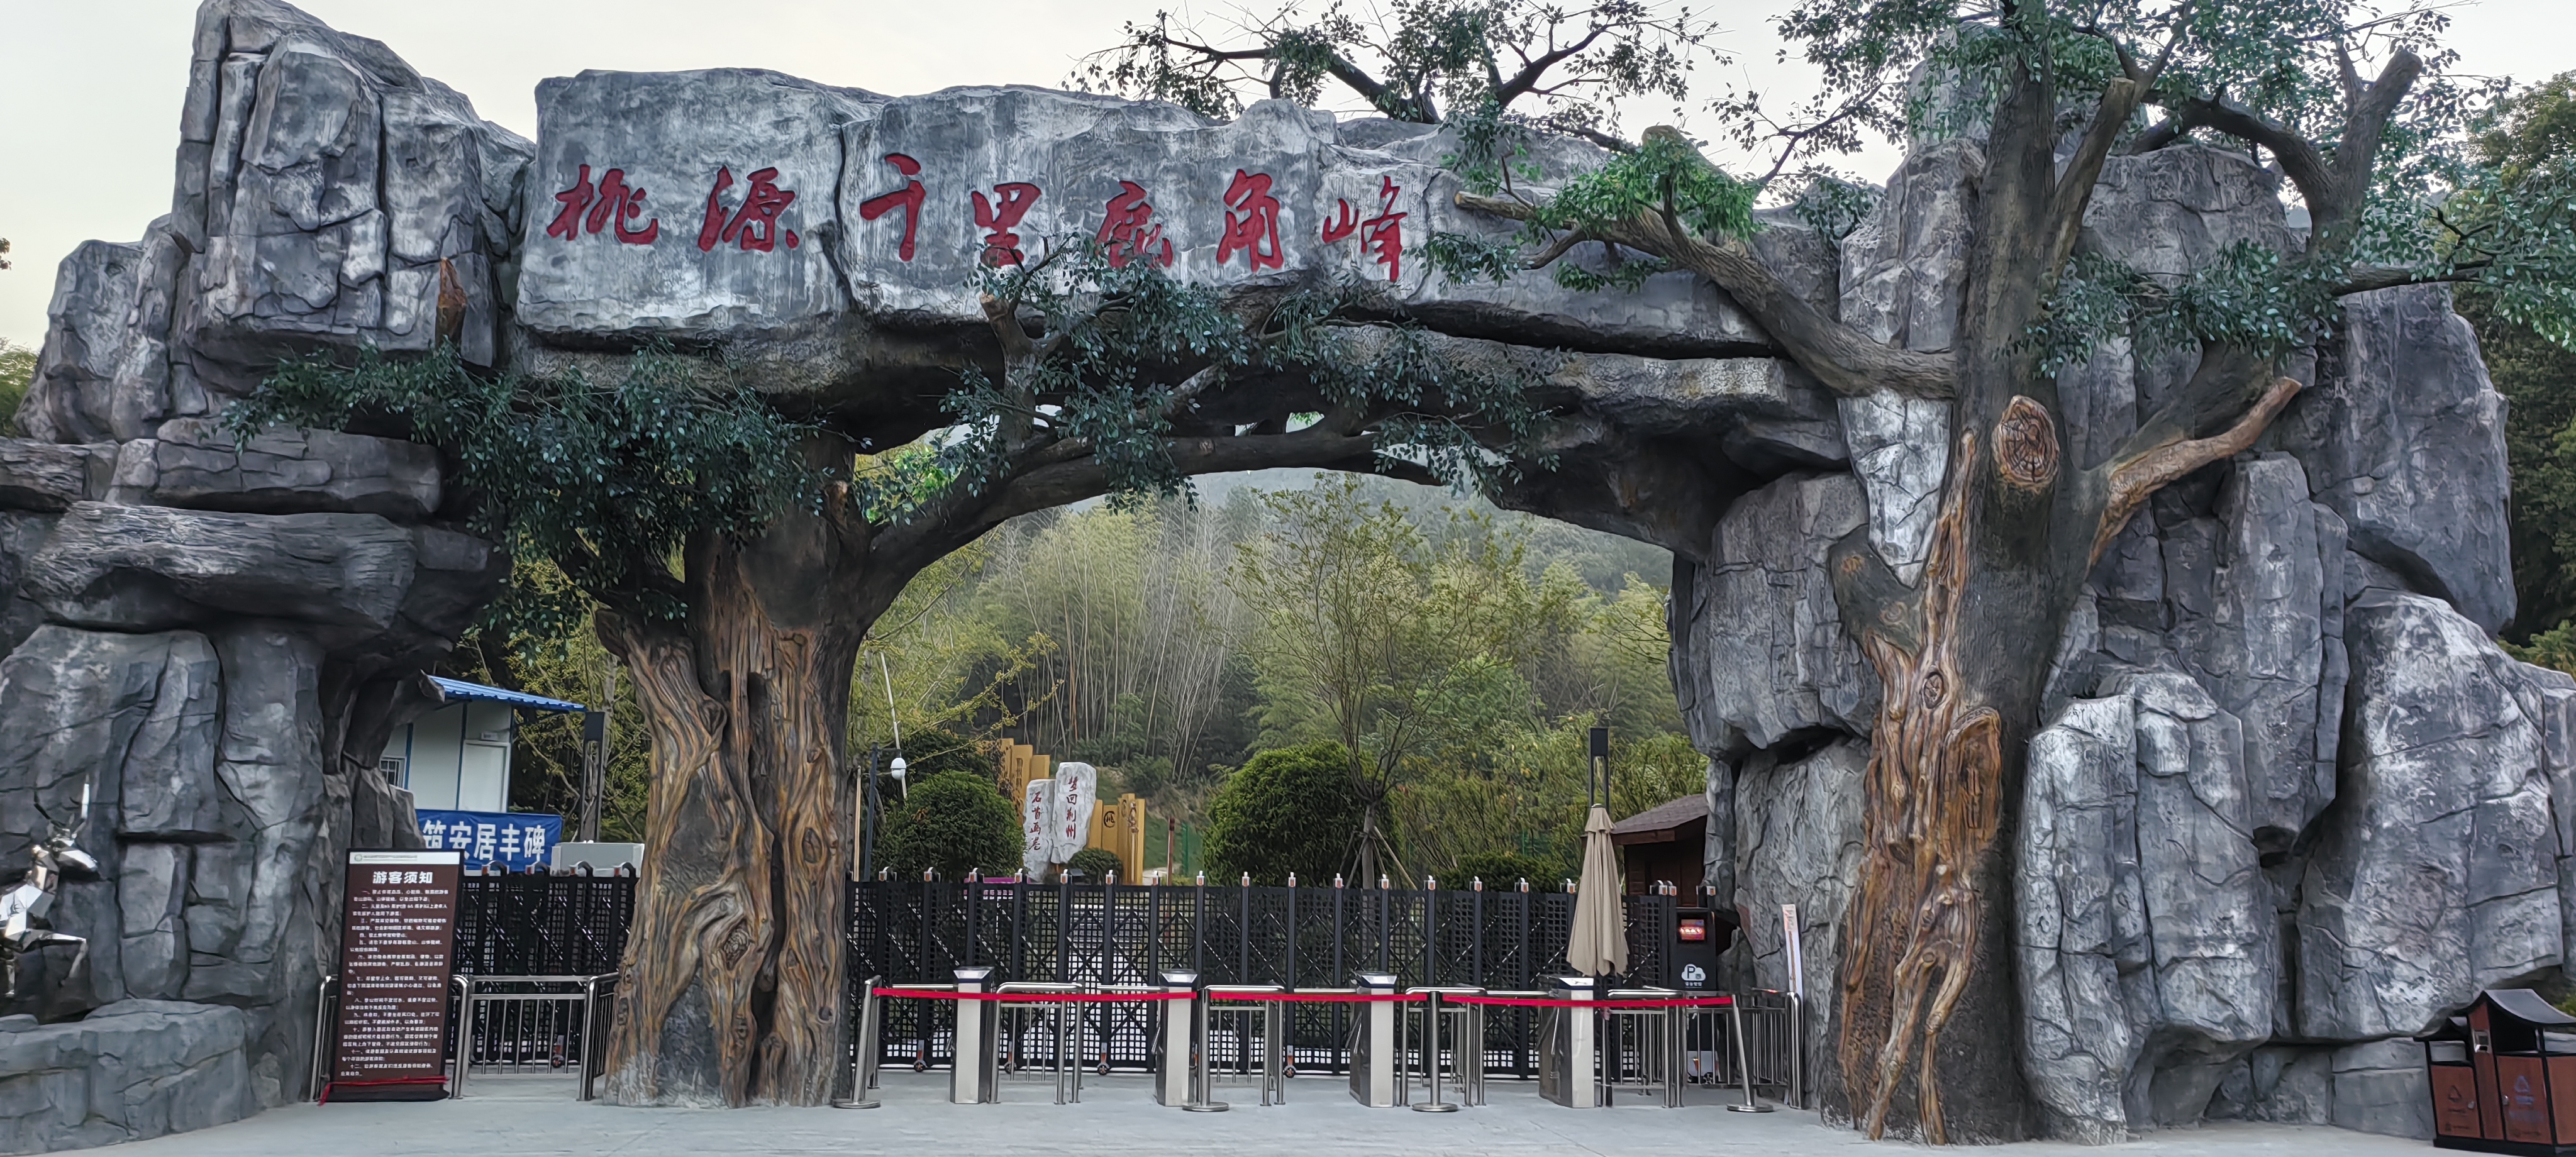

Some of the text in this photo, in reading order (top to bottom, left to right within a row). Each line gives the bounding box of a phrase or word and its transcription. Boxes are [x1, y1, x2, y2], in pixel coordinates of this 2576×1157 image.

[1065, 775, 1079, 840] 梦回荆州
[423, 819, 546, 862] 筑安居丰碑
[372, 871, 433, 884] 游客须知
